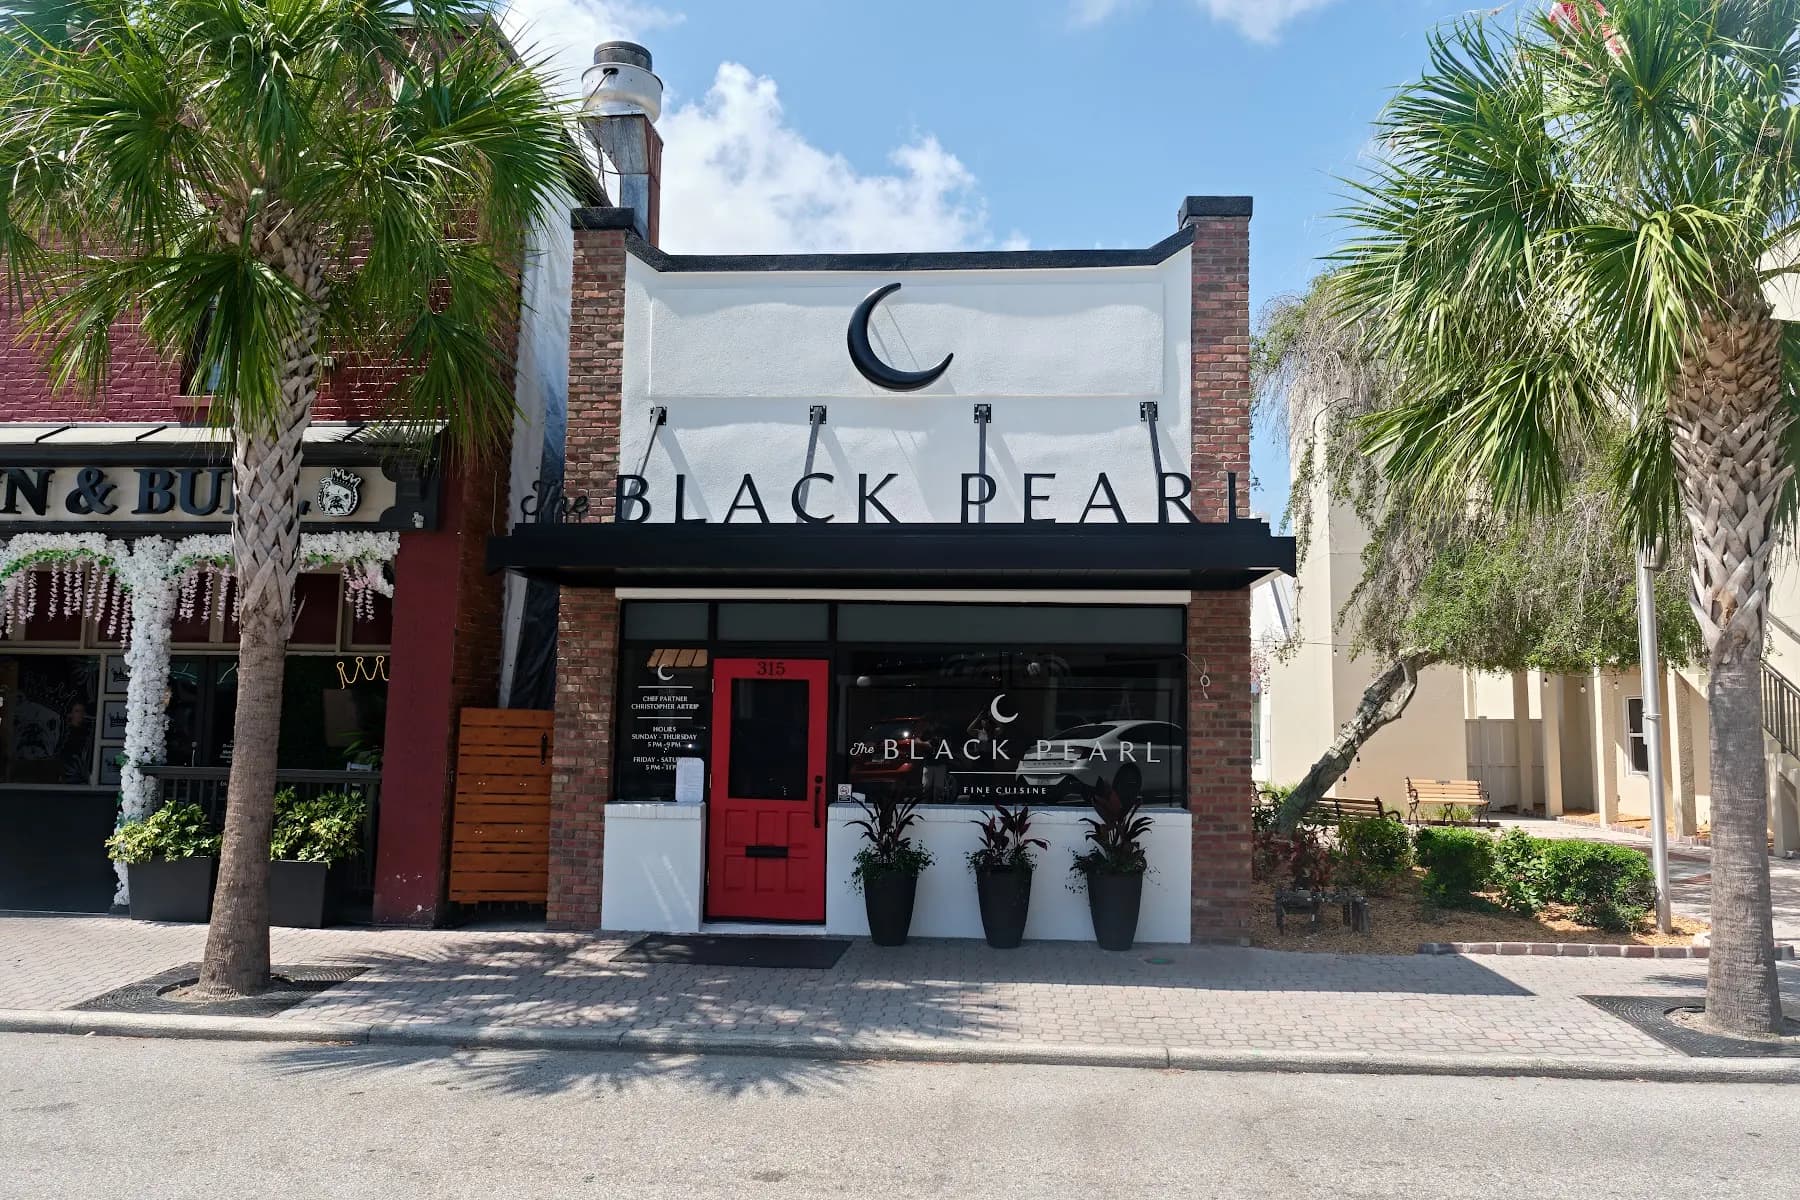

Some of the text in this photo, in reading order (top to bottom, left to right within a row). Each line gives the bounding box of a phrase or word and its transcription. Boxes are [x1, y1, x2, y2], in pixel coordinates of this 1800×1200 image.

[0, 467, 310, 516] N & BU
[615, 472, 901, 525] BLACK
[960, 471, 1258, 525] PEARL
[757, 661, 785, 675] 315
[849, 738, 1161, 764] The BLACK PEARL
[963, 786, 1048, 795] FINE CUISINE
